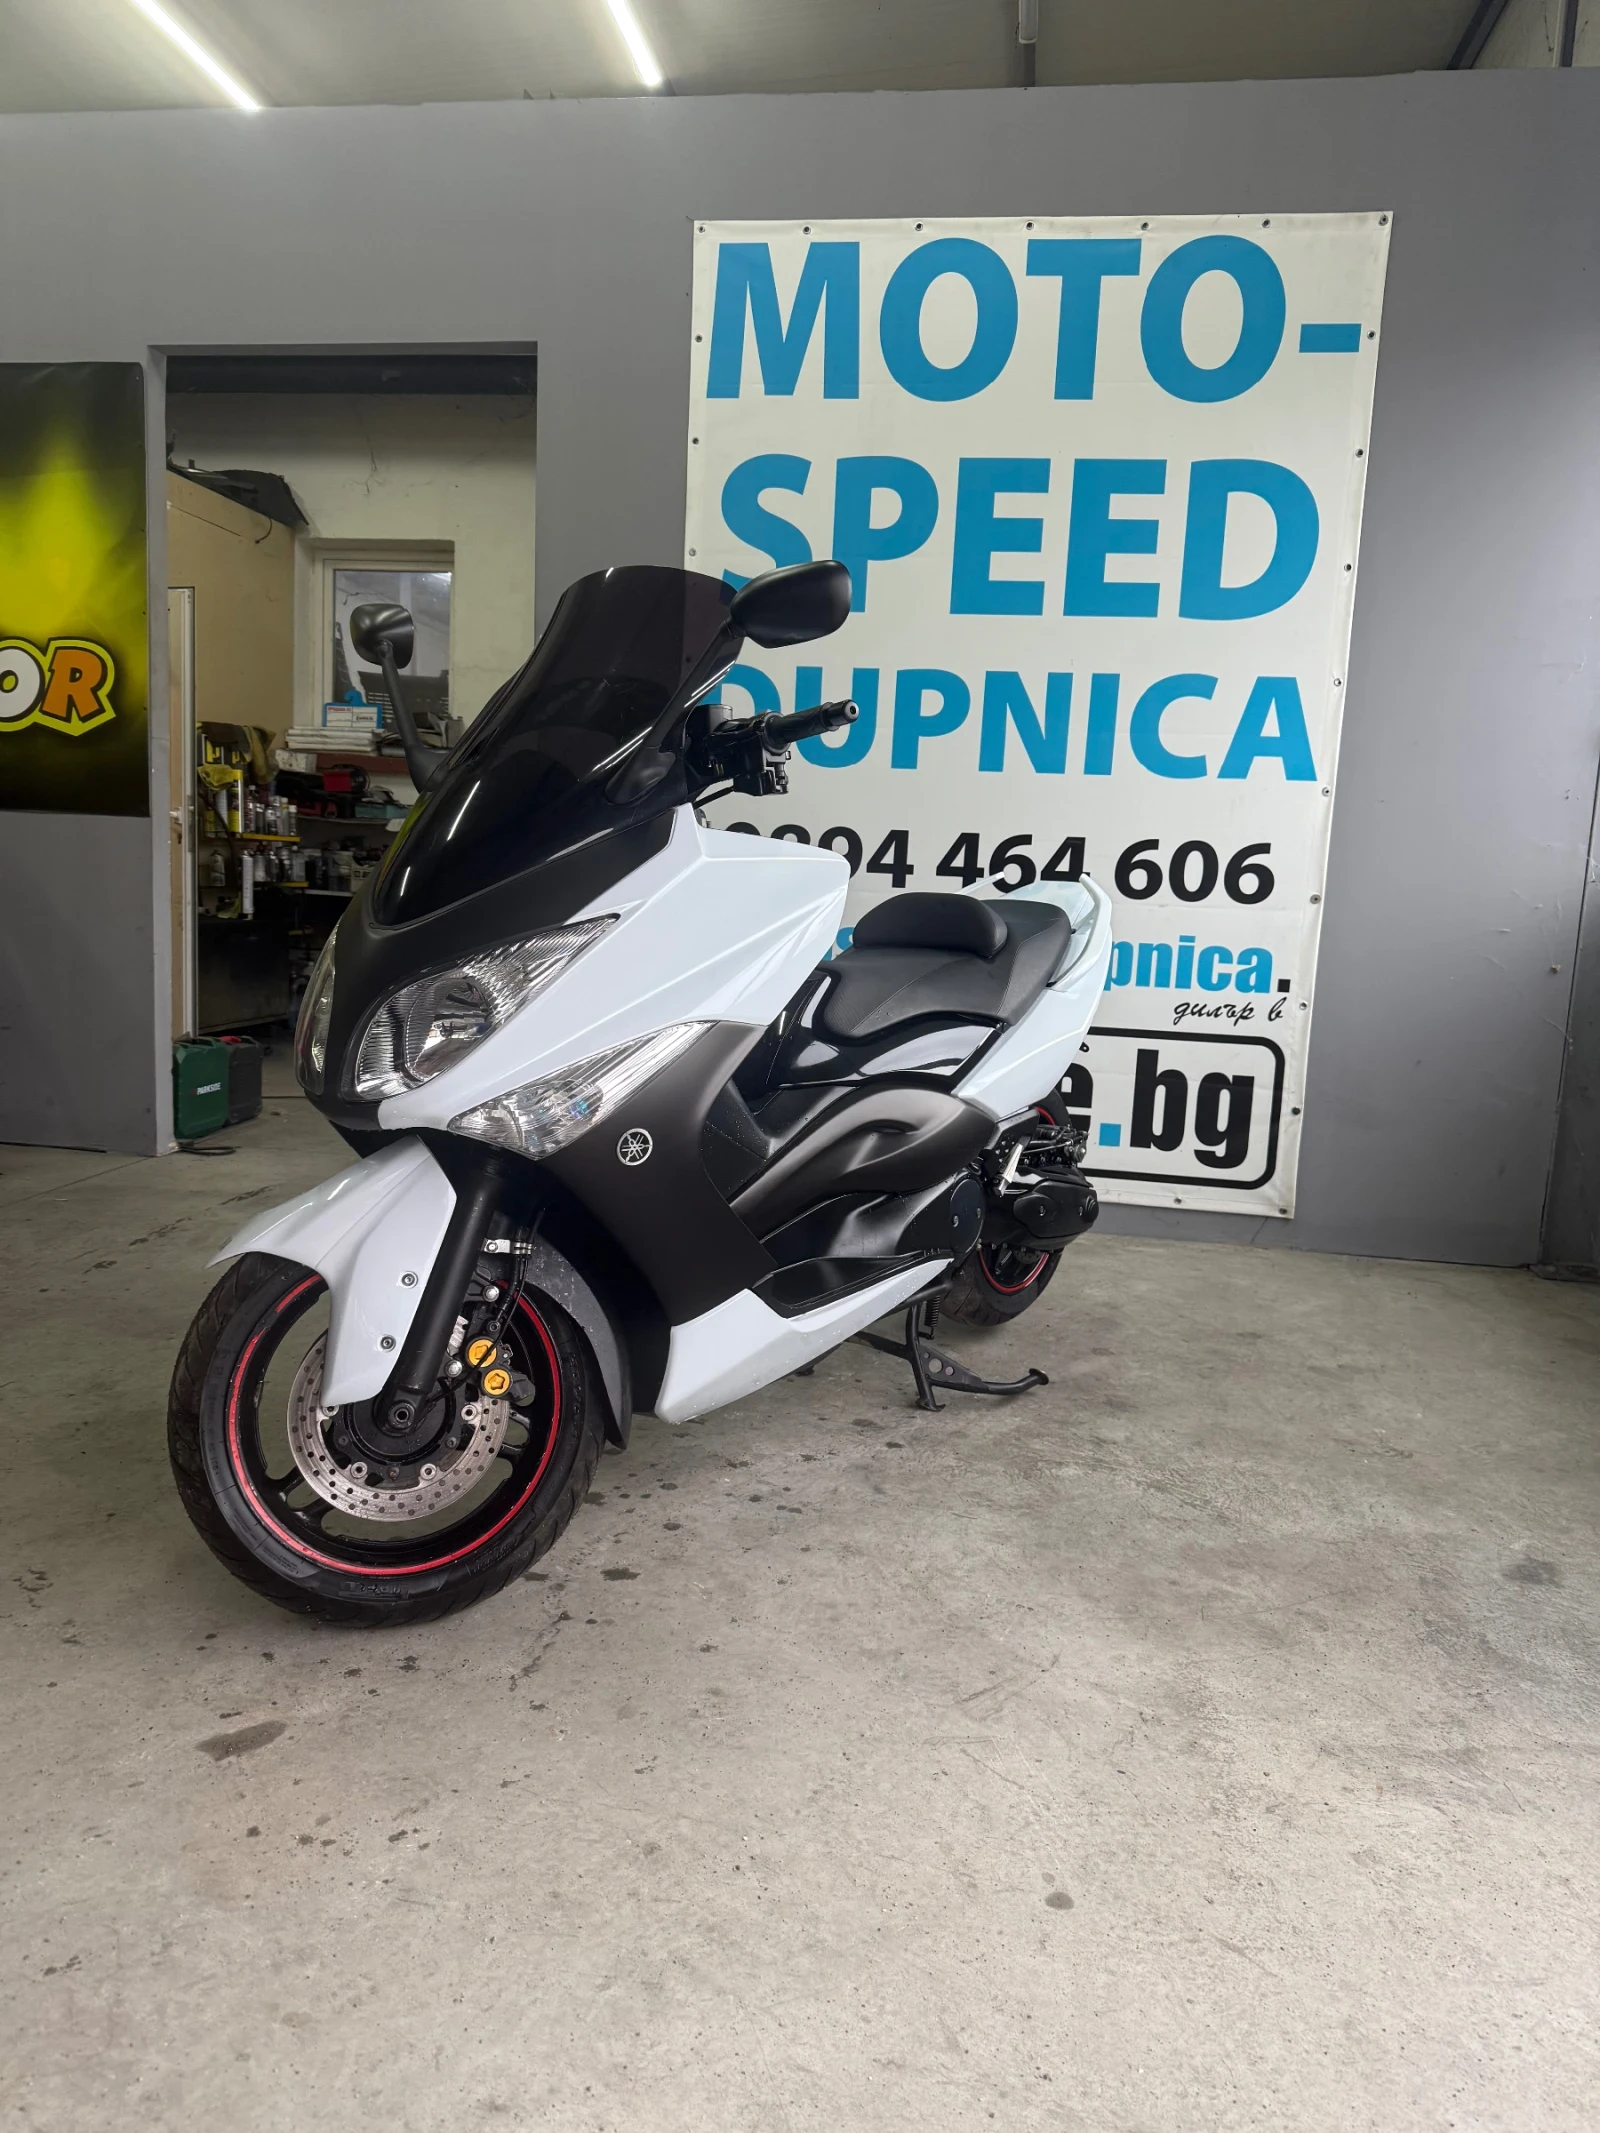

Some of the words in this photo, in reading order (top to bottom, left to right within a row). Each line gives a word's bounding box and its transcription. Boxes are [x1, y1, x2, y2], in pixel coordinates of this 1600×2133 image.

[706, 235, 1362, 403] MOTO-
[720, 453, 1320, 621] SPEED
[724, 821, 914, 888] 94
[935, 832, 1091, 894] 464
[1114, 838, 1275, 905] 606
[197, 1082, 221, 1095] PARKSIDE
